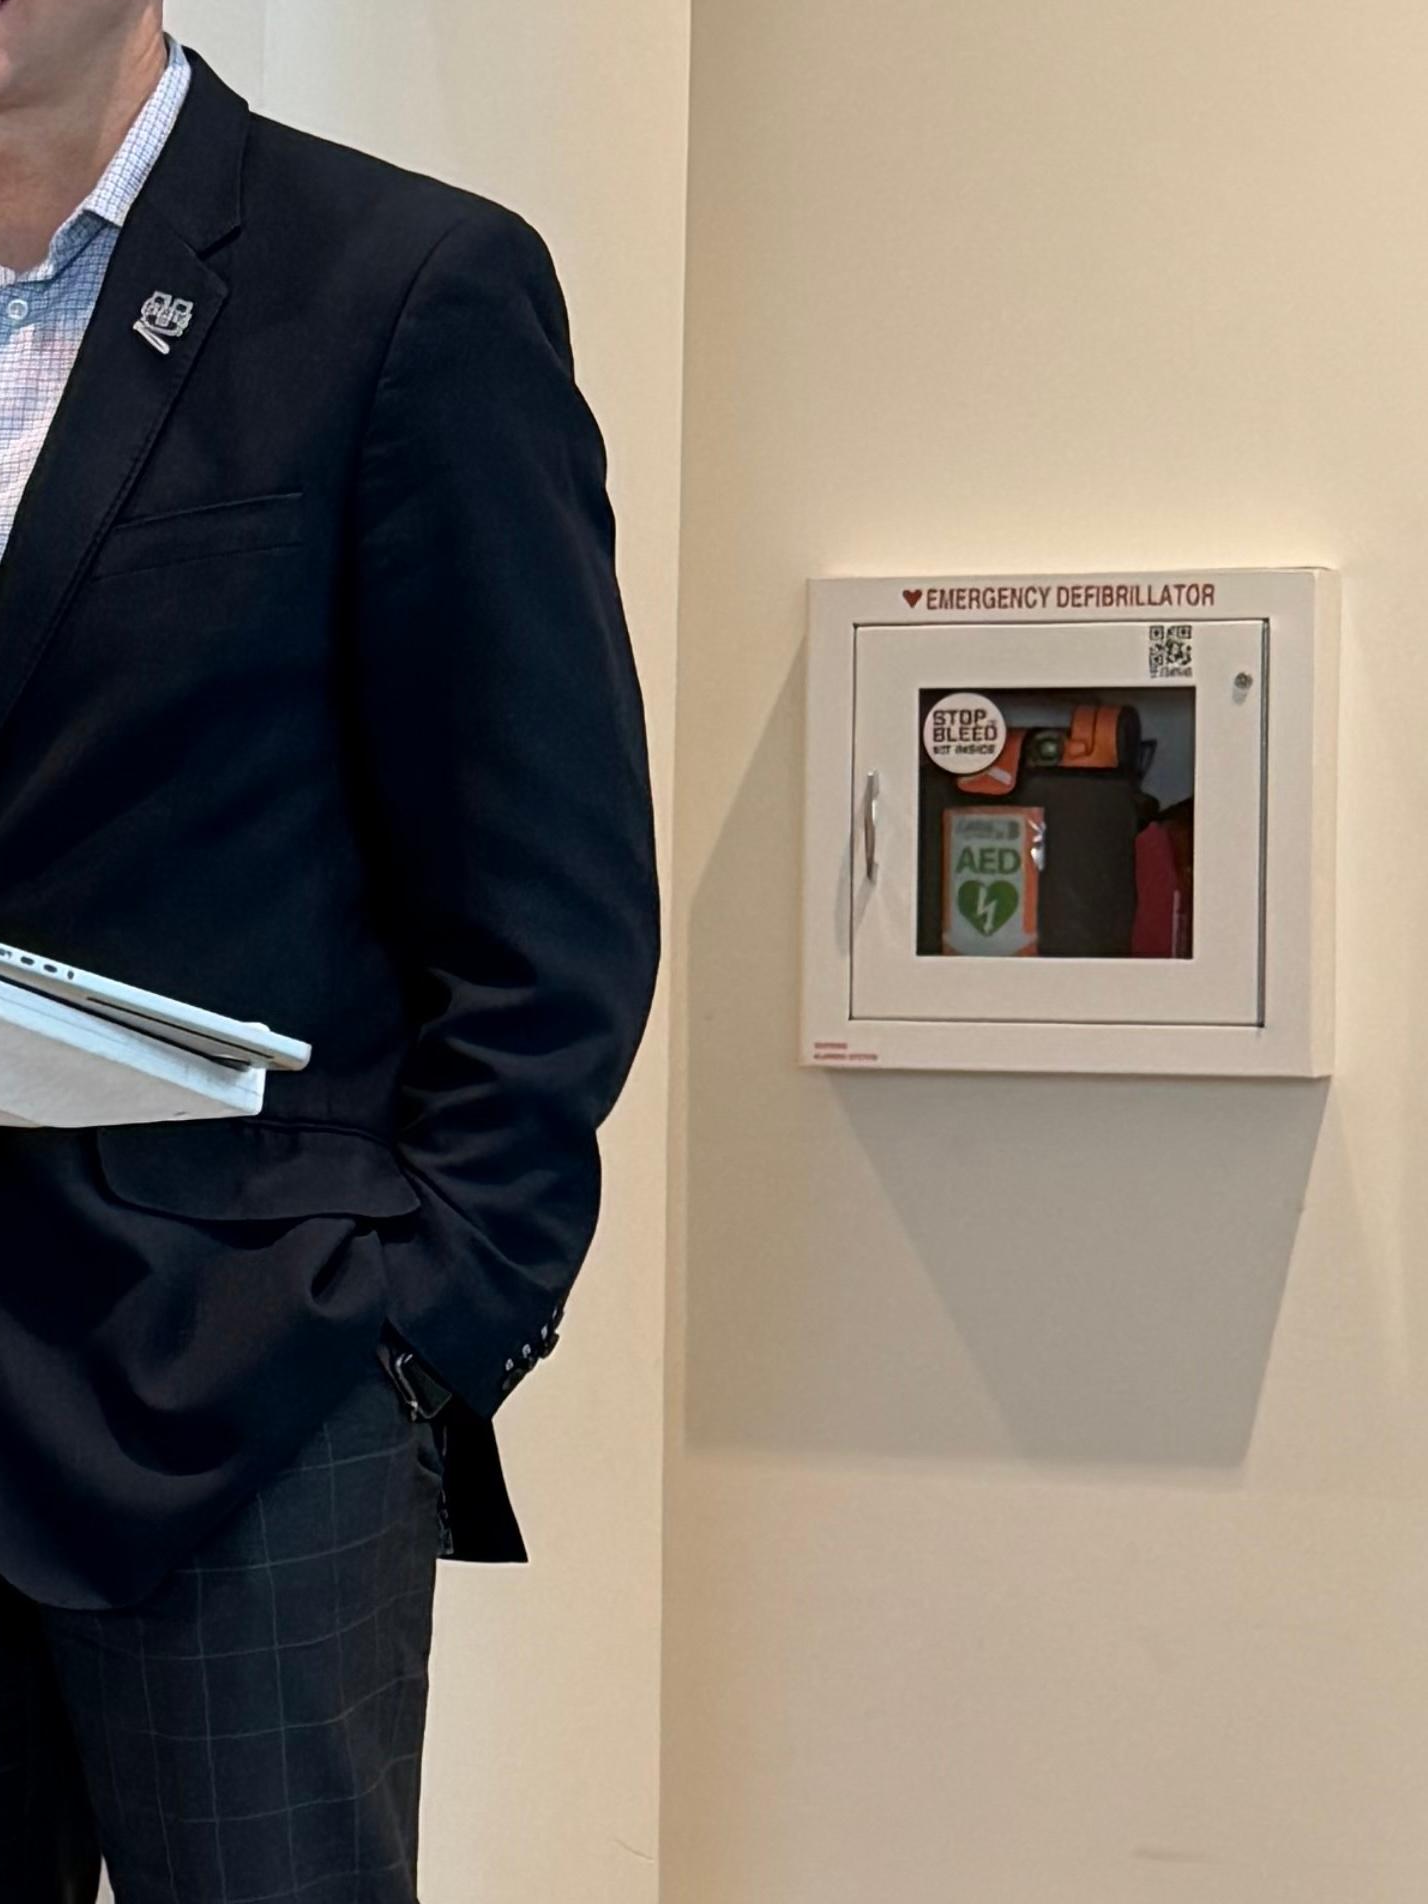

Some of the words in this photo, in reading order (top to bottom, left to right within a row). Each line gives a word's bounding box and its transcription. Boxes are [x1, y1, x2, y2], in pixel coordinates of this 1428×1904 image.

[926, 586, 1051, 610] EMERGENCY
[1056, 583, 1215, 608] DEFIBRILLATOR
[933, 709, 986, 726] STOP
[933, 726, 997, 743] BLEED
[955, 847, 1021, 875] AED
